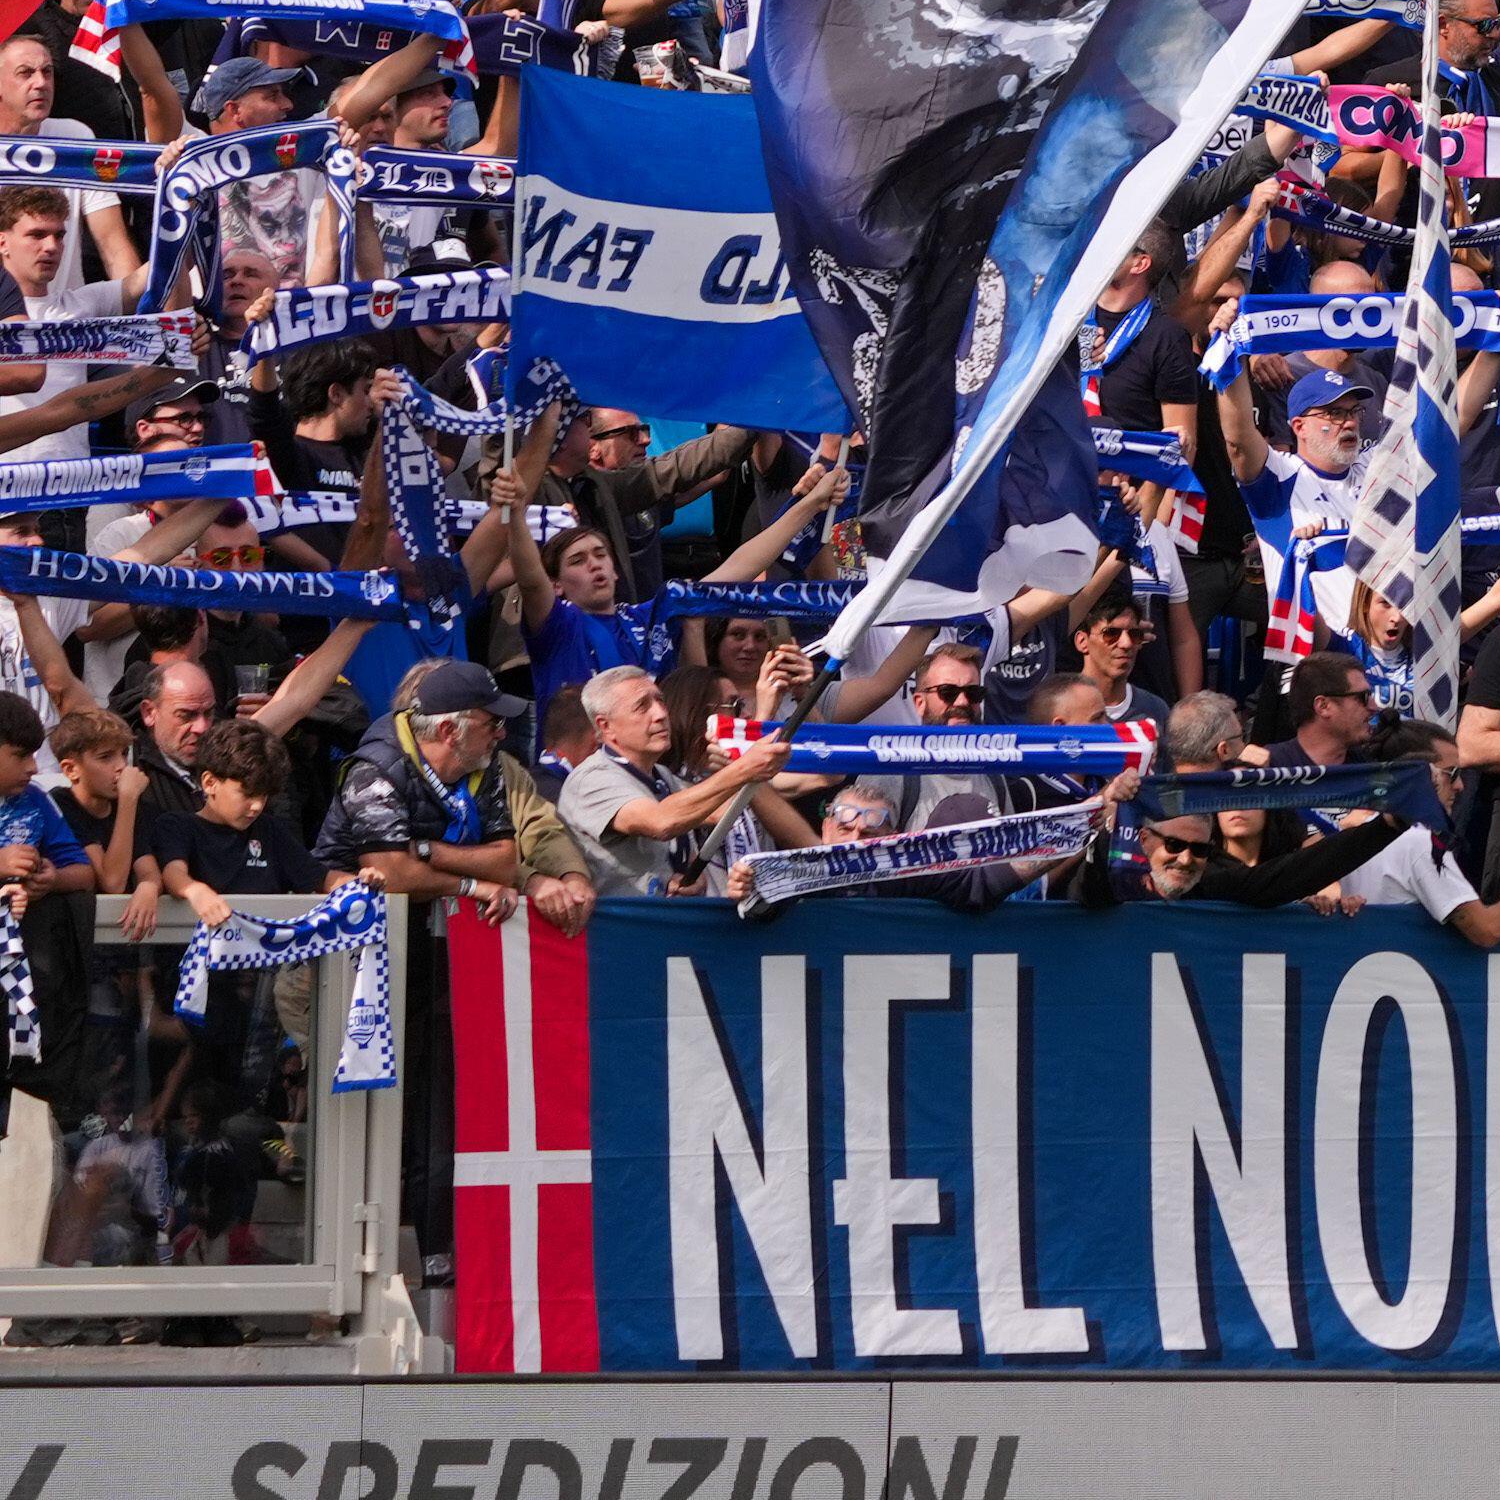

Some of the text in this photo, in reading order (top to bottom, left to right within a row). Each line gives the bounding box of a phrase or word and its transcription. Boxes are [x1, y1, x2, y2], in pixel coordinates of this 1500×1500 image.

[1266, 314, 1300, 328] 1907
[47, 456, 142, 493] CUMASCH
[30, 549, 222, 590] CUMASCH
[666, 954, 1090, 1359] NEL
